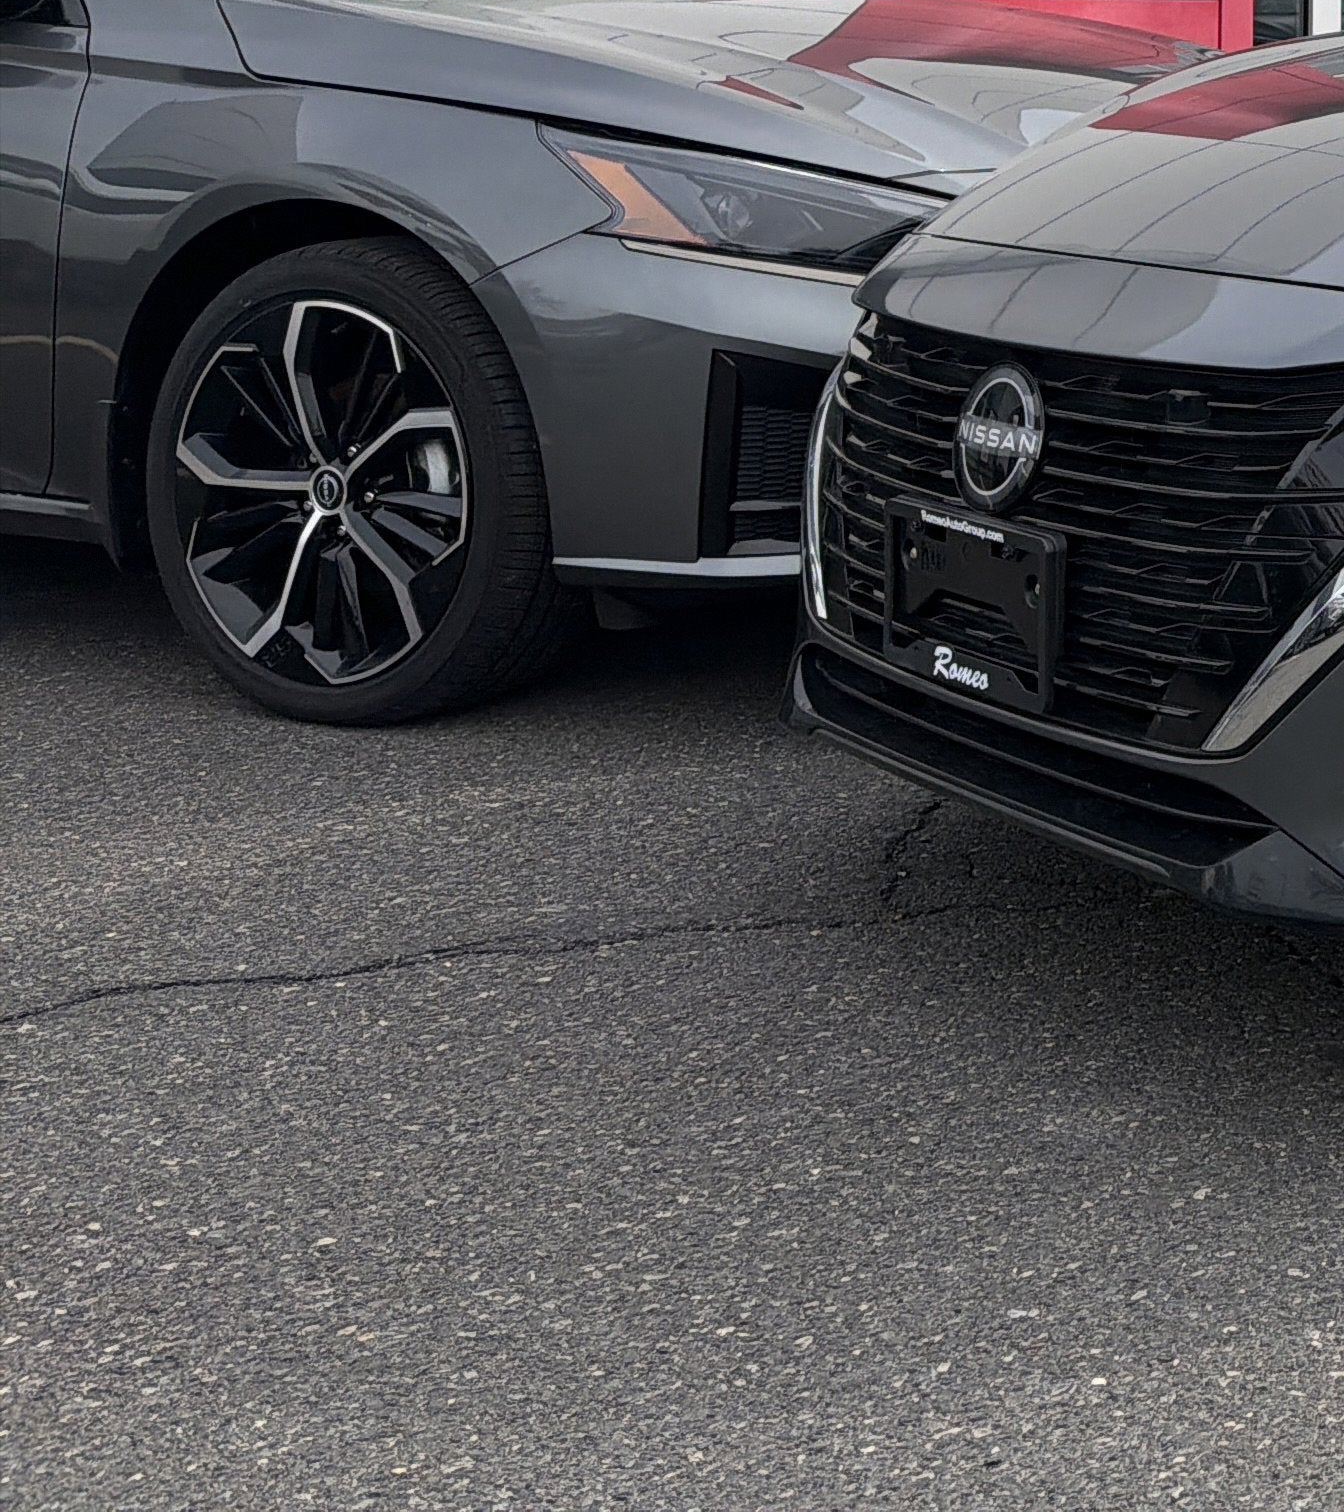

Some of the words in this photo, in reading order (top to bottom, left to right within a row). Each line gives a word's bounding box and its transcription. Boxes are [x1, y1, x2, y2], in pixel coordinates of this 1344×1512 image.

[959, 419, 1037, 454] NISSAN
[921, 509, 1004, 543] RomeoAutoGroup.com
[933, 645, 989, 690] Romeo
